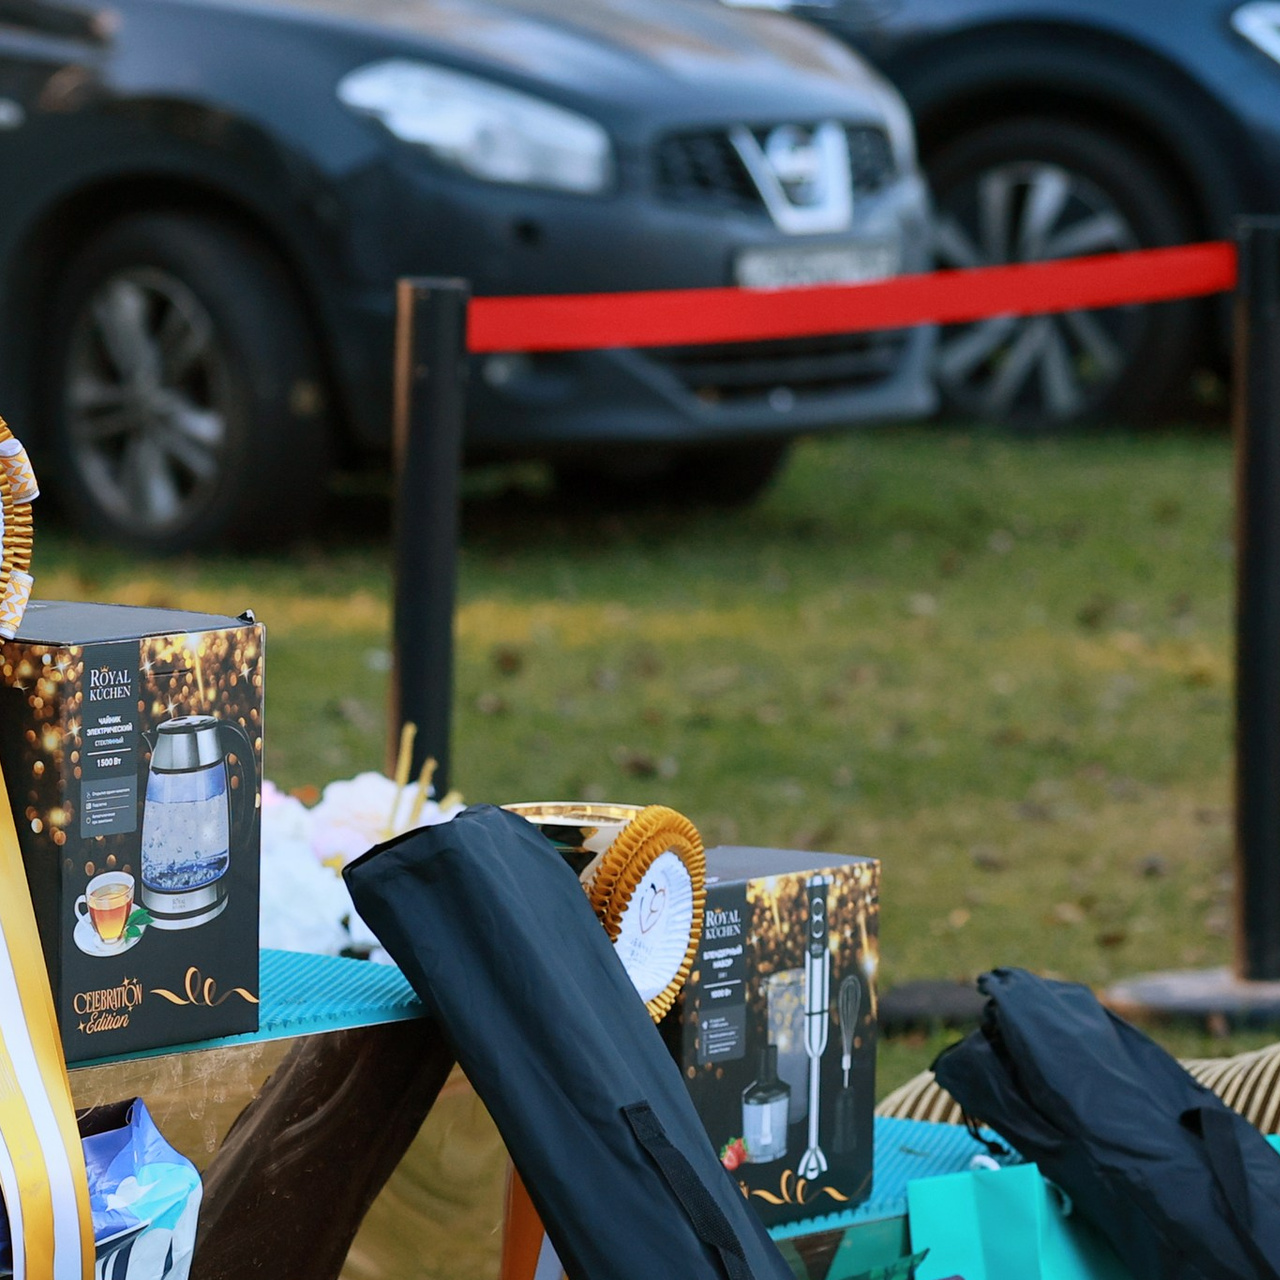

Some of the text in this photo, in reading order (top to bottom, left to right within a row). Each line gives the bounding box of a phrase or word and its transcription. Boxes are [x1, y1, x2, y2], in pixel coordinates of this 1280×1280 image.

[90, 669, 132, 688] ROYAL
[89, 685, 132, 702] KÜCHEN
[96, 758, 113, 768] 1500
[705, 909, 741, 928] ROYAL
[73, 983, 143, 1015] CELEBRATION
[85, 1012, 130, 1035] Edition
